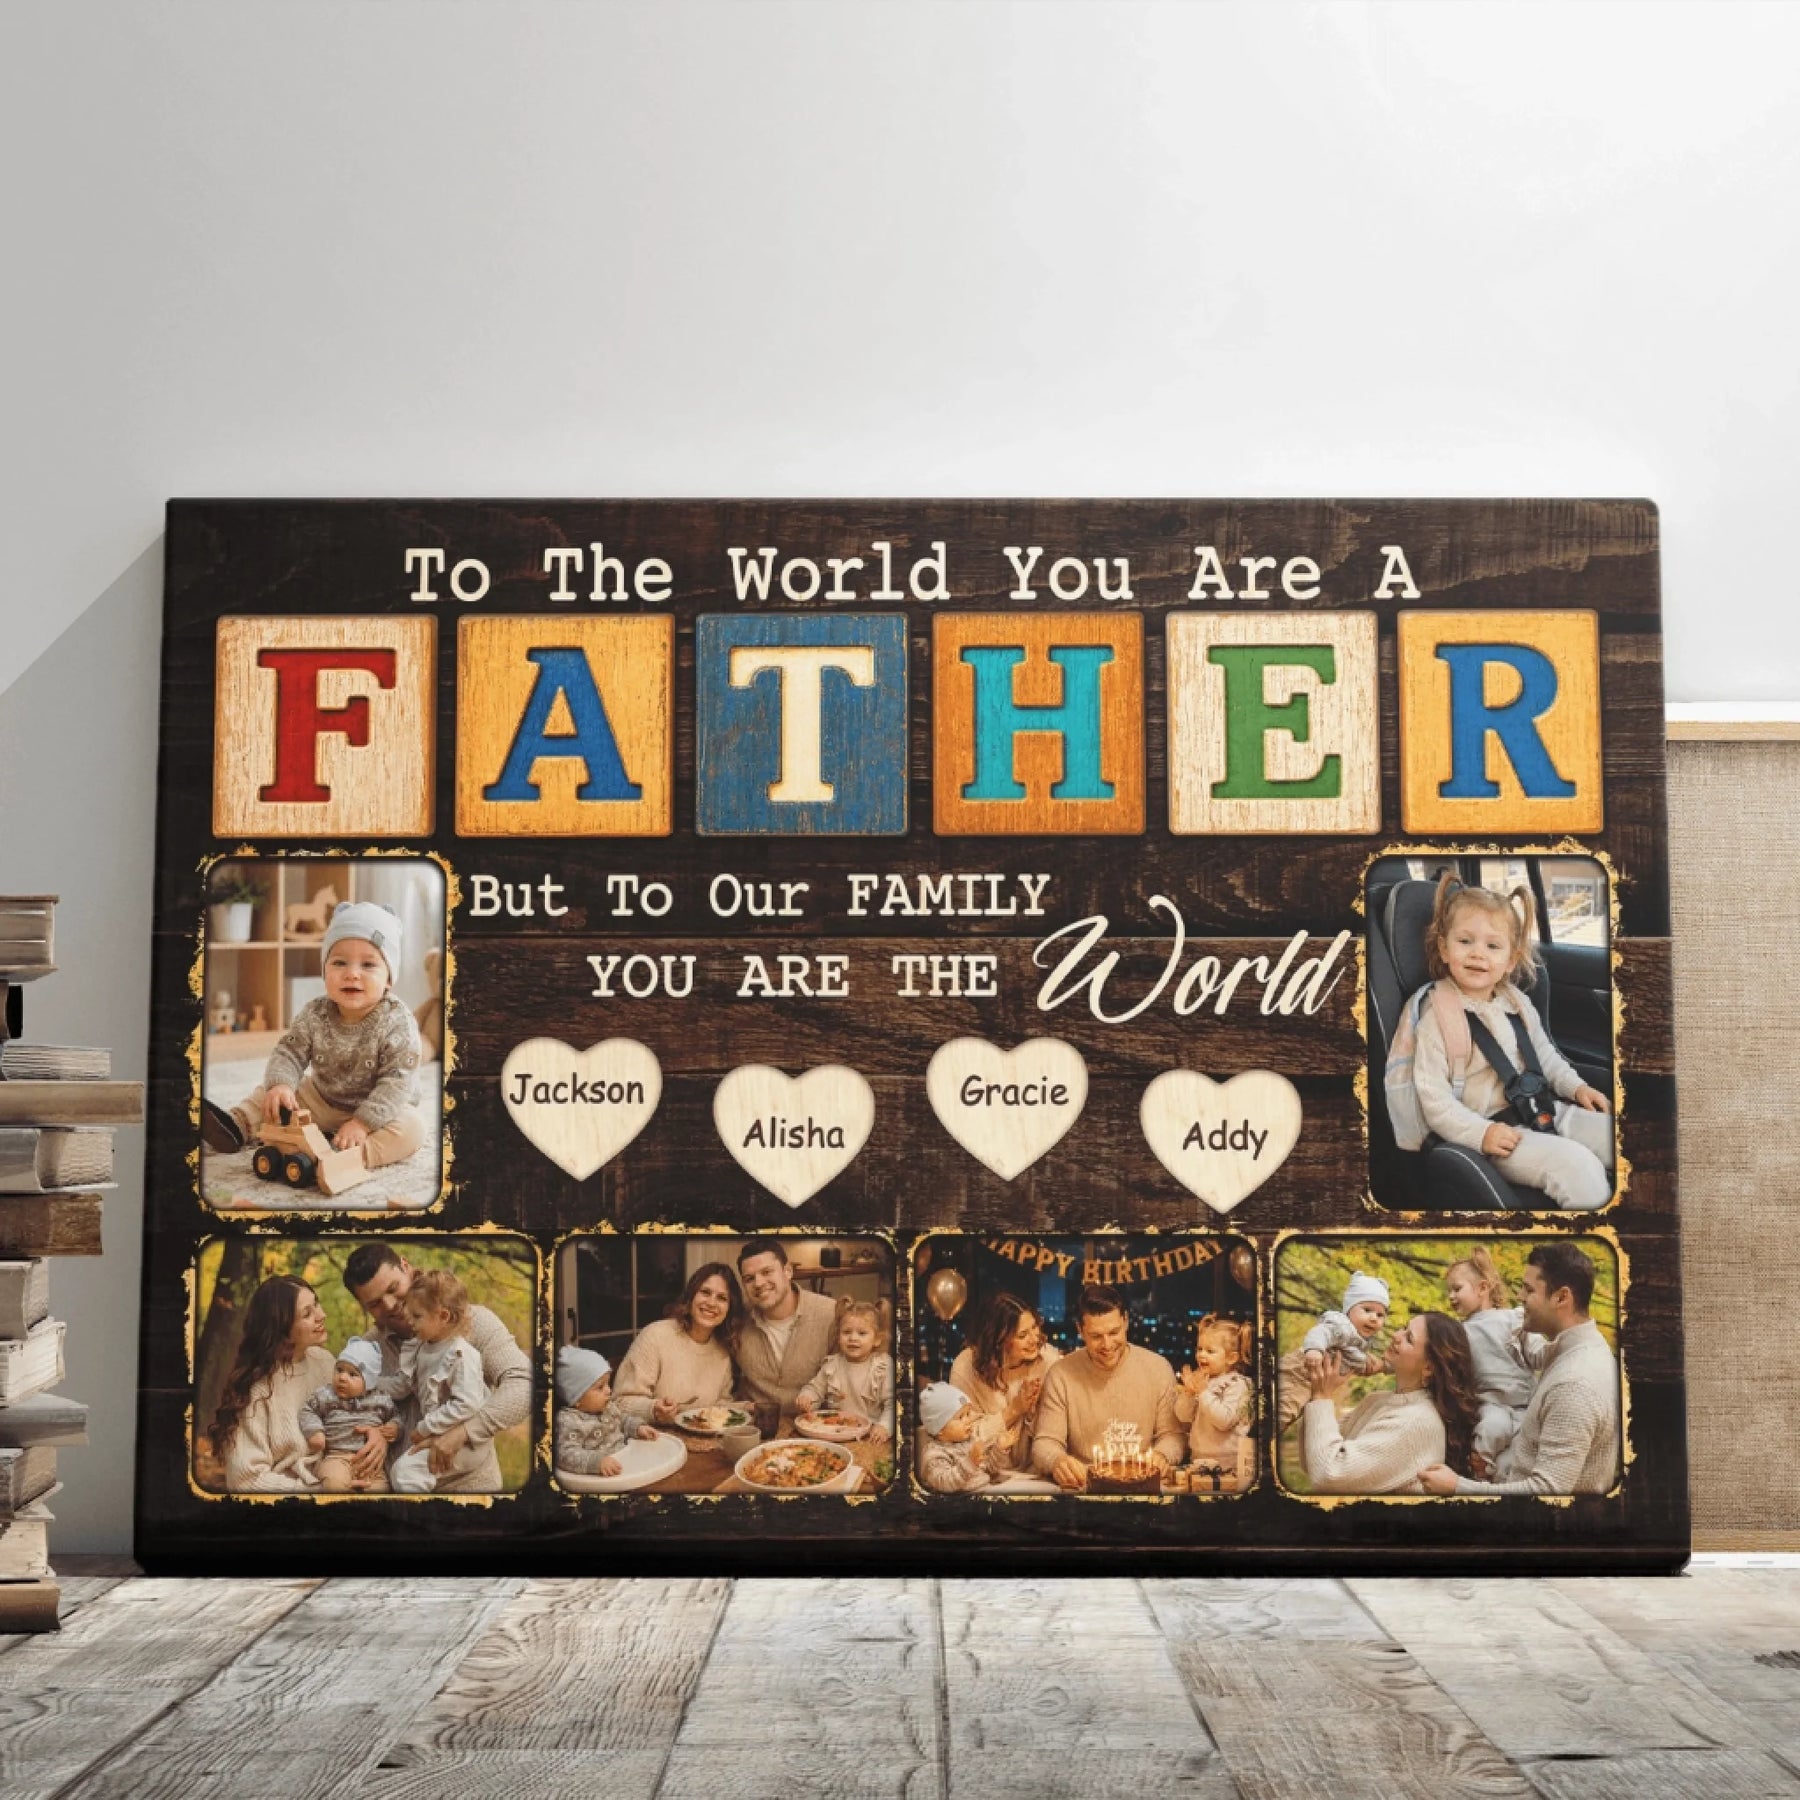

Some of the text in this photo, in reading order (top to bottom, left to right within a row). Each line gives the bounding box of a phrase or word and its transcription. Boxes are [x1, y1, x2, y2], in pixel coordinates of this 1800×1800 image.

[405, 541, 1421, 602] To The World You Are A
[258, 643, 1577, 802] FATHER
[469, 873, 1051, 918] But To Our FAMILY
[587, 894, 1351, 1024] YOU ARE THE World
[509, 1072, 645, 1105] Jackson
[960, 1074, 1069, 1107] Gracie
[742, 1116, 846, 1150] Alisha
[1182, 1119, 1268, 1160] Addy
